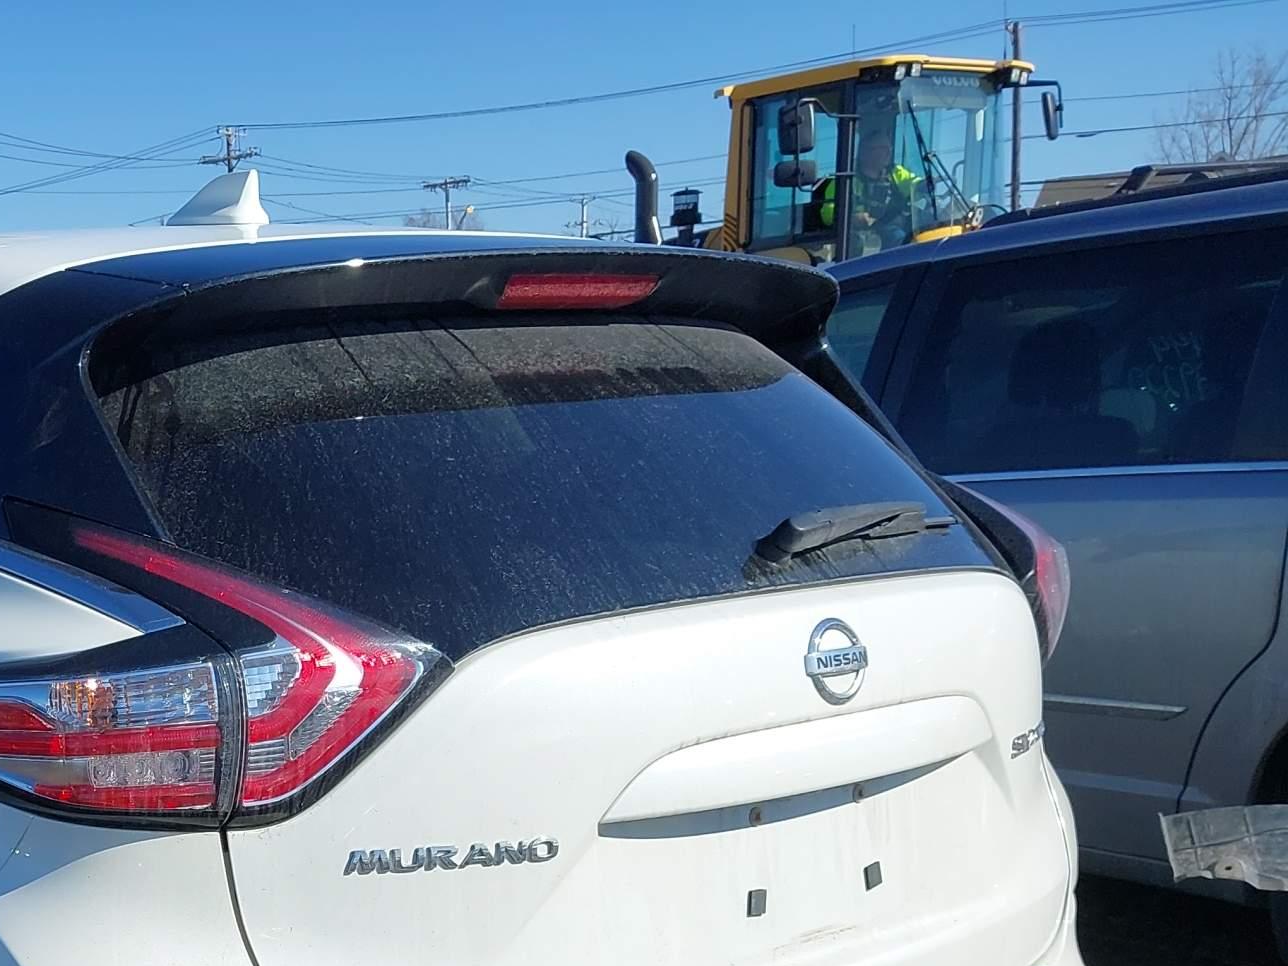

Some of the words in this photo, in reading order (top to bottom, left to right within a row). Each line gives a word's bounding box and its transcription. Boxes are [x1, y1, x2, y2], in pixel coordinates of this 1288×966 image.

[932, 76, 981, 88] VOLVO
[816, 650, 865, 670] NISSAN
[342, 836, 560, 877] MURANO
